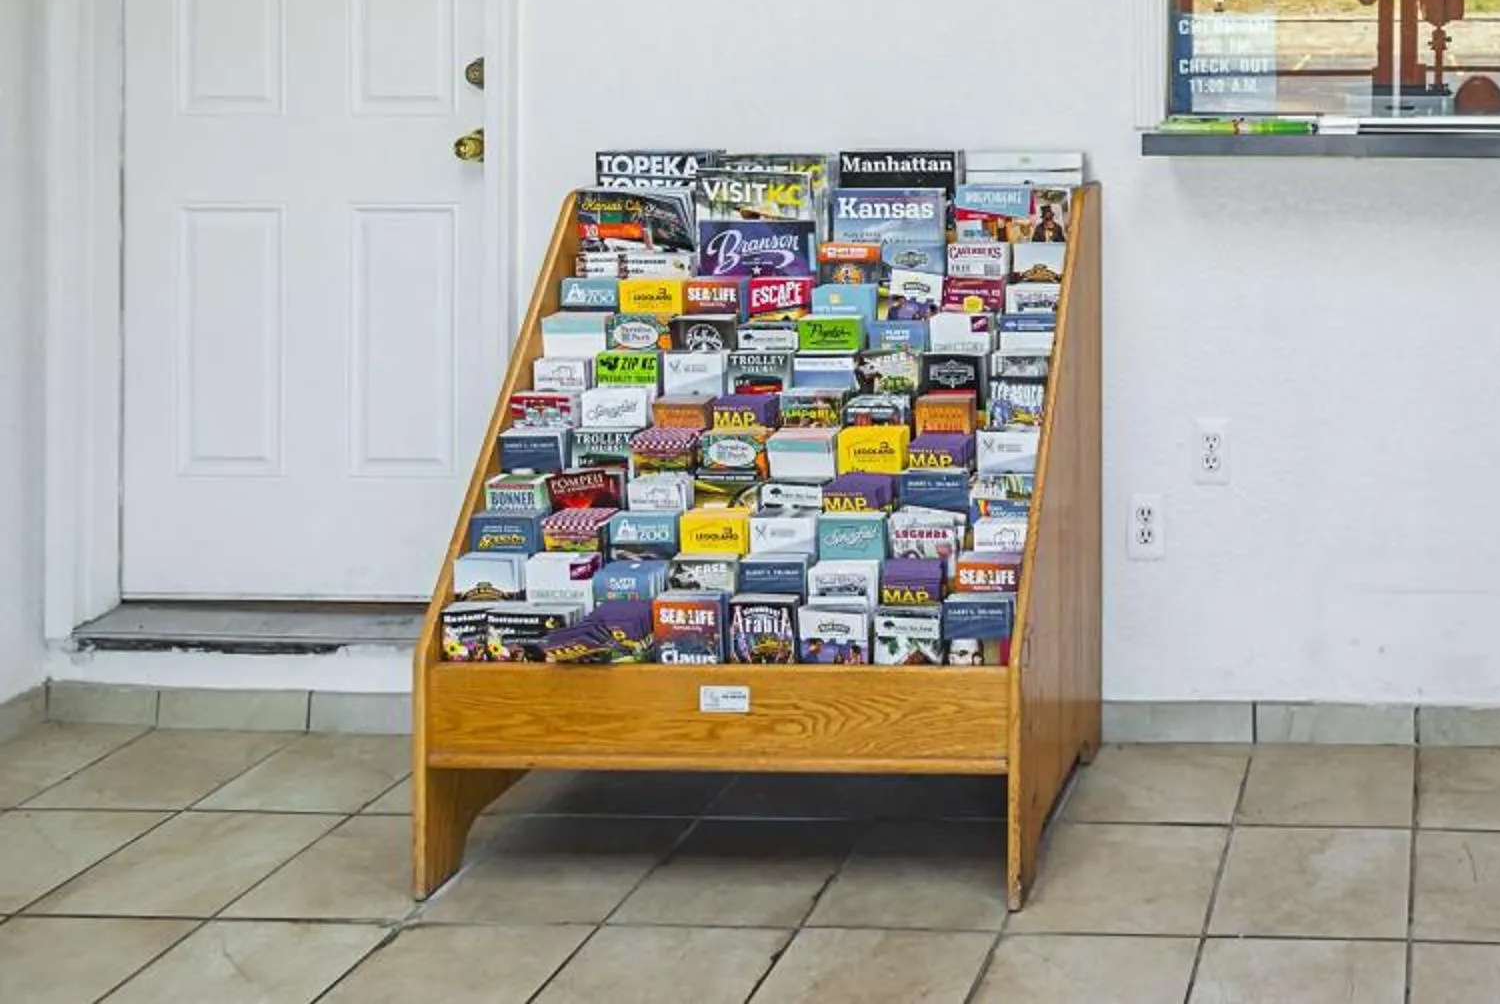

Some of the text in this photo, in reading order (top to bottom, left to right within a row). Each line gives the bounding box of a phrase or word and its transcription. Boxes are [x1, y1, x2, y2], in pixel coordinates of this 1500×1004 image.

[1179, 59, 1269, 74] CHECK OUT
[598, 155, 702, 176] TOPEKA
[841, 155, 953, 173] Manhattan
[837, 196, 935, 220] Kansas
[706, 229, 800, 276] Branson
[687, 287, 737, 303] SEA LIFE
[751, 280, 802, 309] ESCAPE
[621, 357, 639, 371] ZIP
[730, 355, 785, 366] TROLLEY
[713, 411, 756, 428] MAP
[576, 433, 630, 445] TROLLEY
[909, 454, 952, 468] MAP
[823, 498, 867, 512] MAP
[638, 531, 669, 541] ZOO
[959, 569, 1016, 585] SEA LIFE
[882, 589, 929, 604] MAP
[659, 608, 715, 625] SEA LIFE
